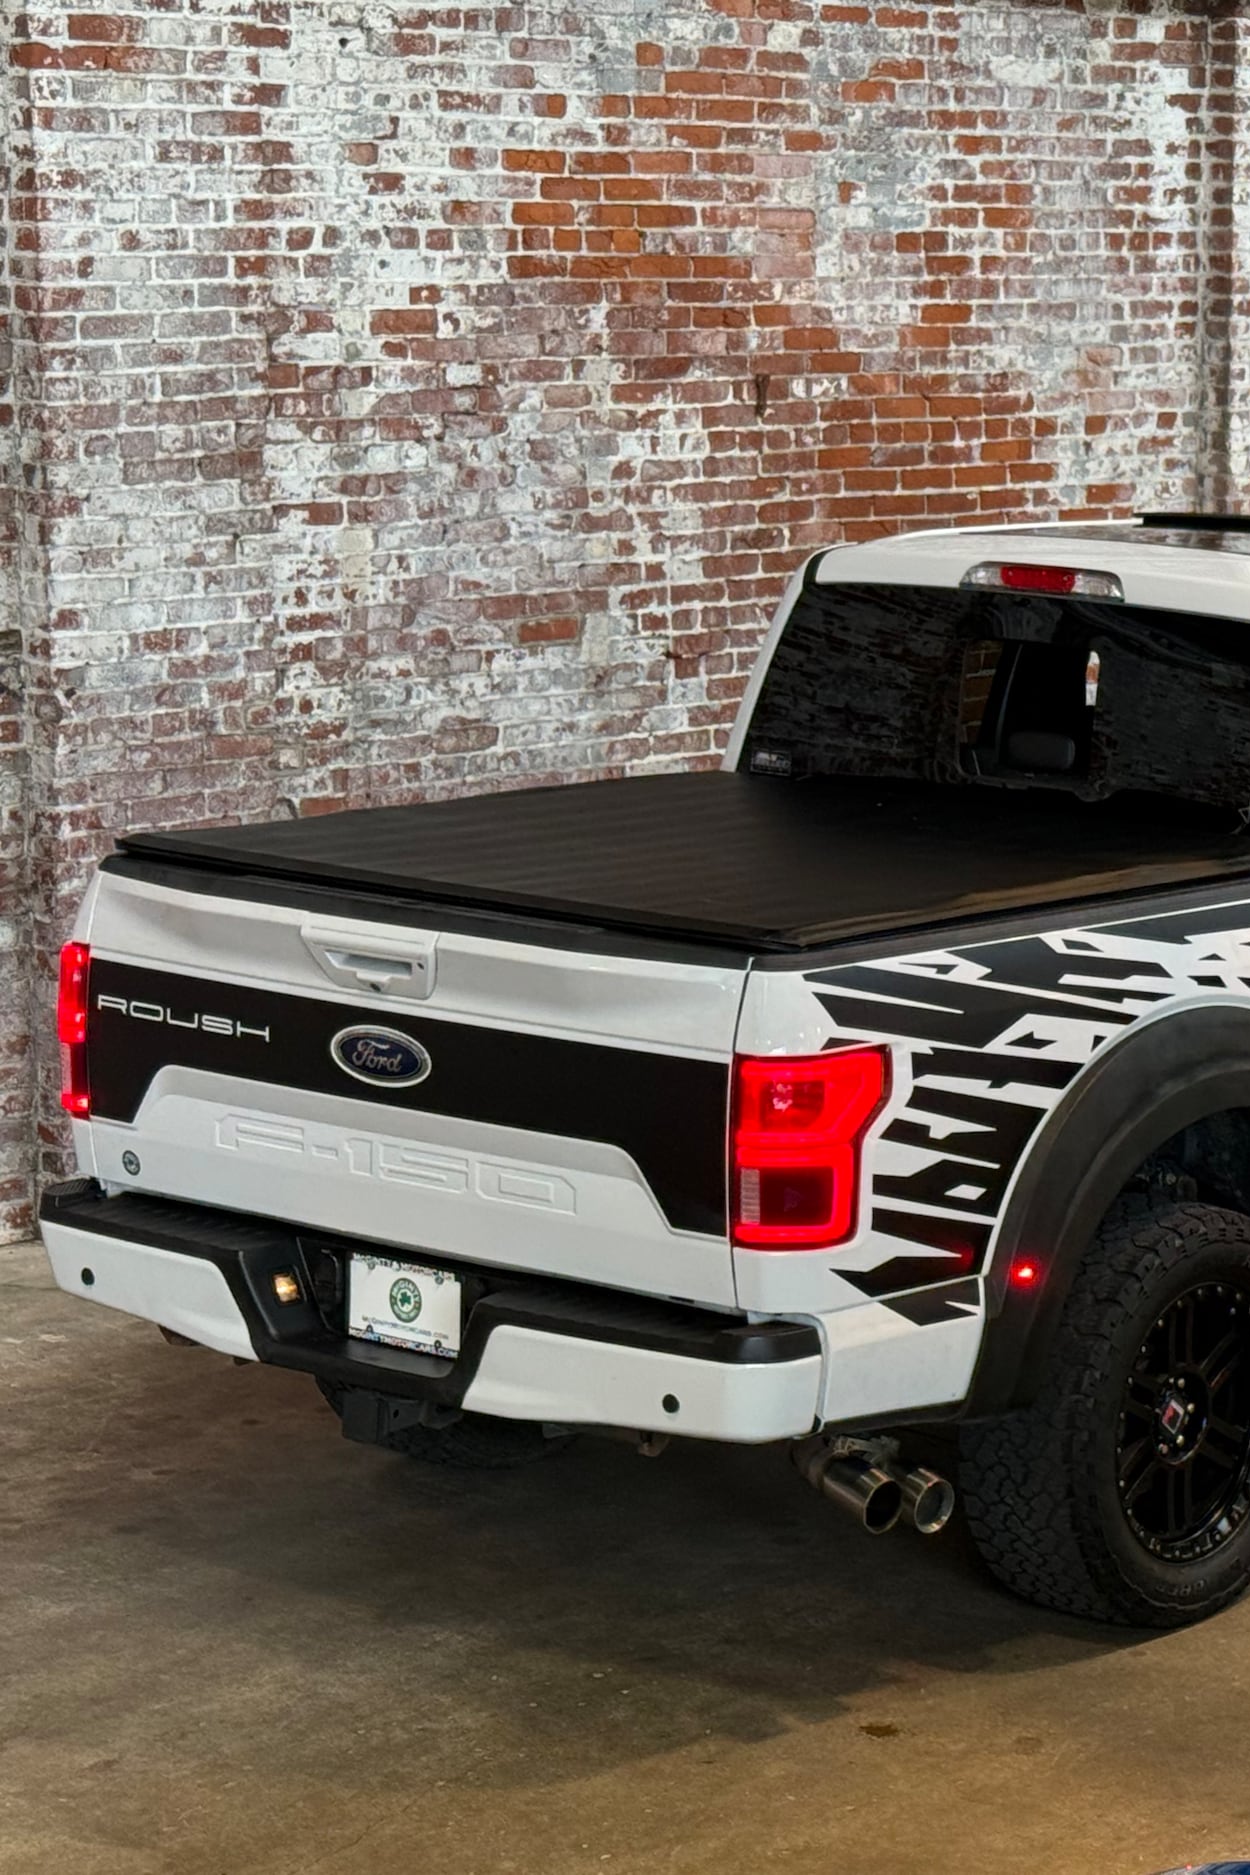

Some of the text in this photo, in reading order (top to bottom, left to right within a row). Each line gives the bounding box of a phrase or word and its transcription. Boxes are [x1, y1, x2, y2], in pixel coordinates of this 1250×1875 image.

[97, 994, 270, 1043] ROUSH
[351, 1039, 403, 1073] Ford
[214, 1113, 577, 1217] F-150
